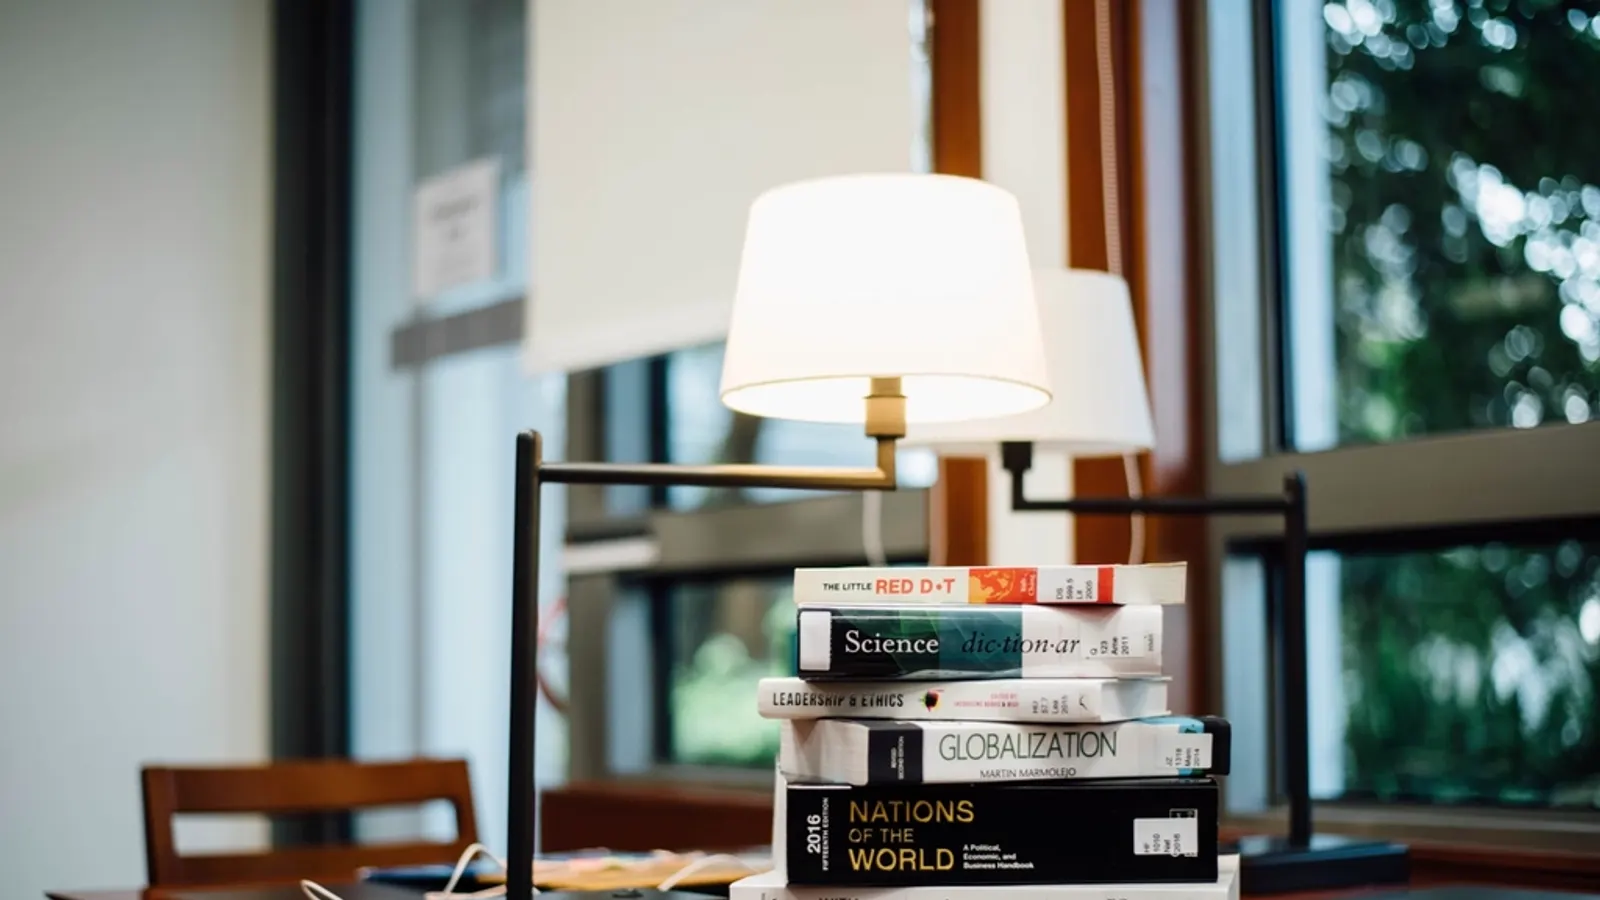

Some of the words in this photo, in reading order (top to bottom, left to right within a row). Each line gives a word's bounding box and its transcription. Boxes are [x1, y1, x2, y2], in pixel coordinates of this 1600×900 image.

[823, 583, 840, 591] THE
[842, 583, 872, 591] LITTLE
[875, 579, 914, 594] RED
[845, 630, 939, 653] Science
[1100, 640, 1109, 655] 123
[1121, 636, 1130, 655] 2011
[772, 692, 846, 707] LEADERSHIP
[849, 694, 856, 707] &
[861, 693, 904, 707] ETHICS
[938, 731, 1117, 761] GLOBALIZATION
[980, 769, 1016, 779] MARTIN
[1019, 767, 1076, 779] MARMOLEJO
[849, 800, 974, 823] NATIONS
[807, 814, 821, 853] 2016
[848, 828, 873, 843] OF
[879, 828, 914, 843] THE
[848, 848, 955, 871] WORLD
[963, 853, 1000, 861] Economic,
[1002, 853, 1016, 861] and
